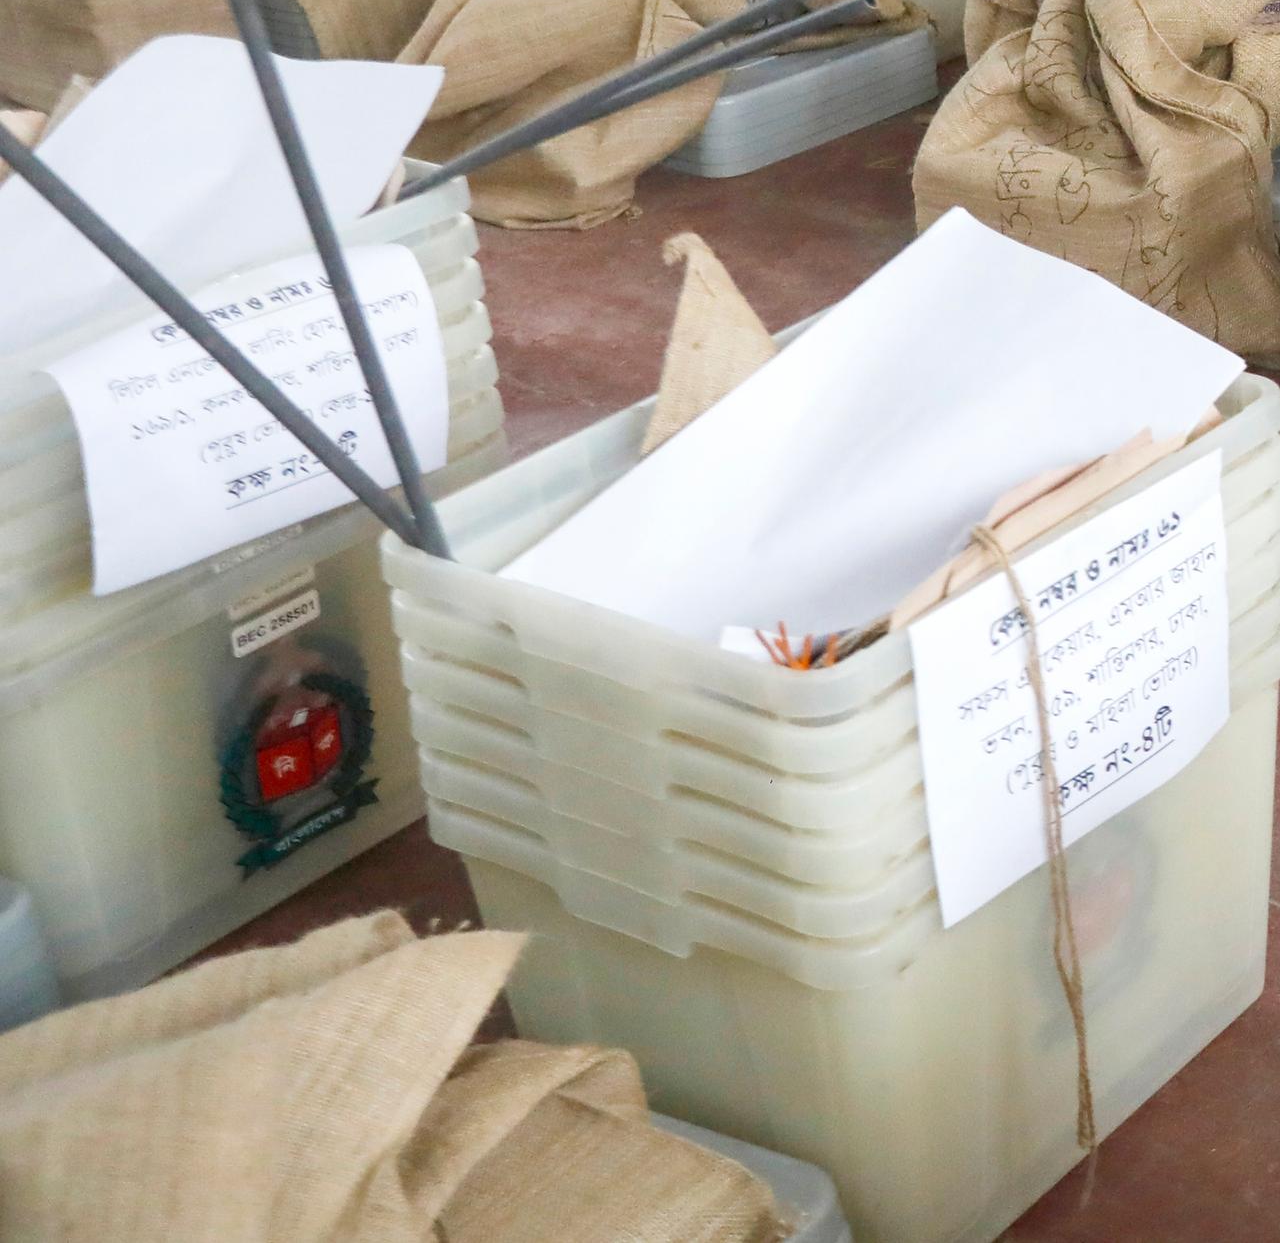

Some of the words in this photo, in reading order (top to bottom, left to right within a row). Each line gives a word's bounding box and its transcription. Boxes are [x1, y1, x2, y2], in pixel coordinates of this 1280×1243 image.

[224, 466, 273, 499] কক্ষ
[1036, 570, 1078, 609] নম্বর
[1085, 559, 1101, 582] ও
[237, 623, 267, 648] BEC
